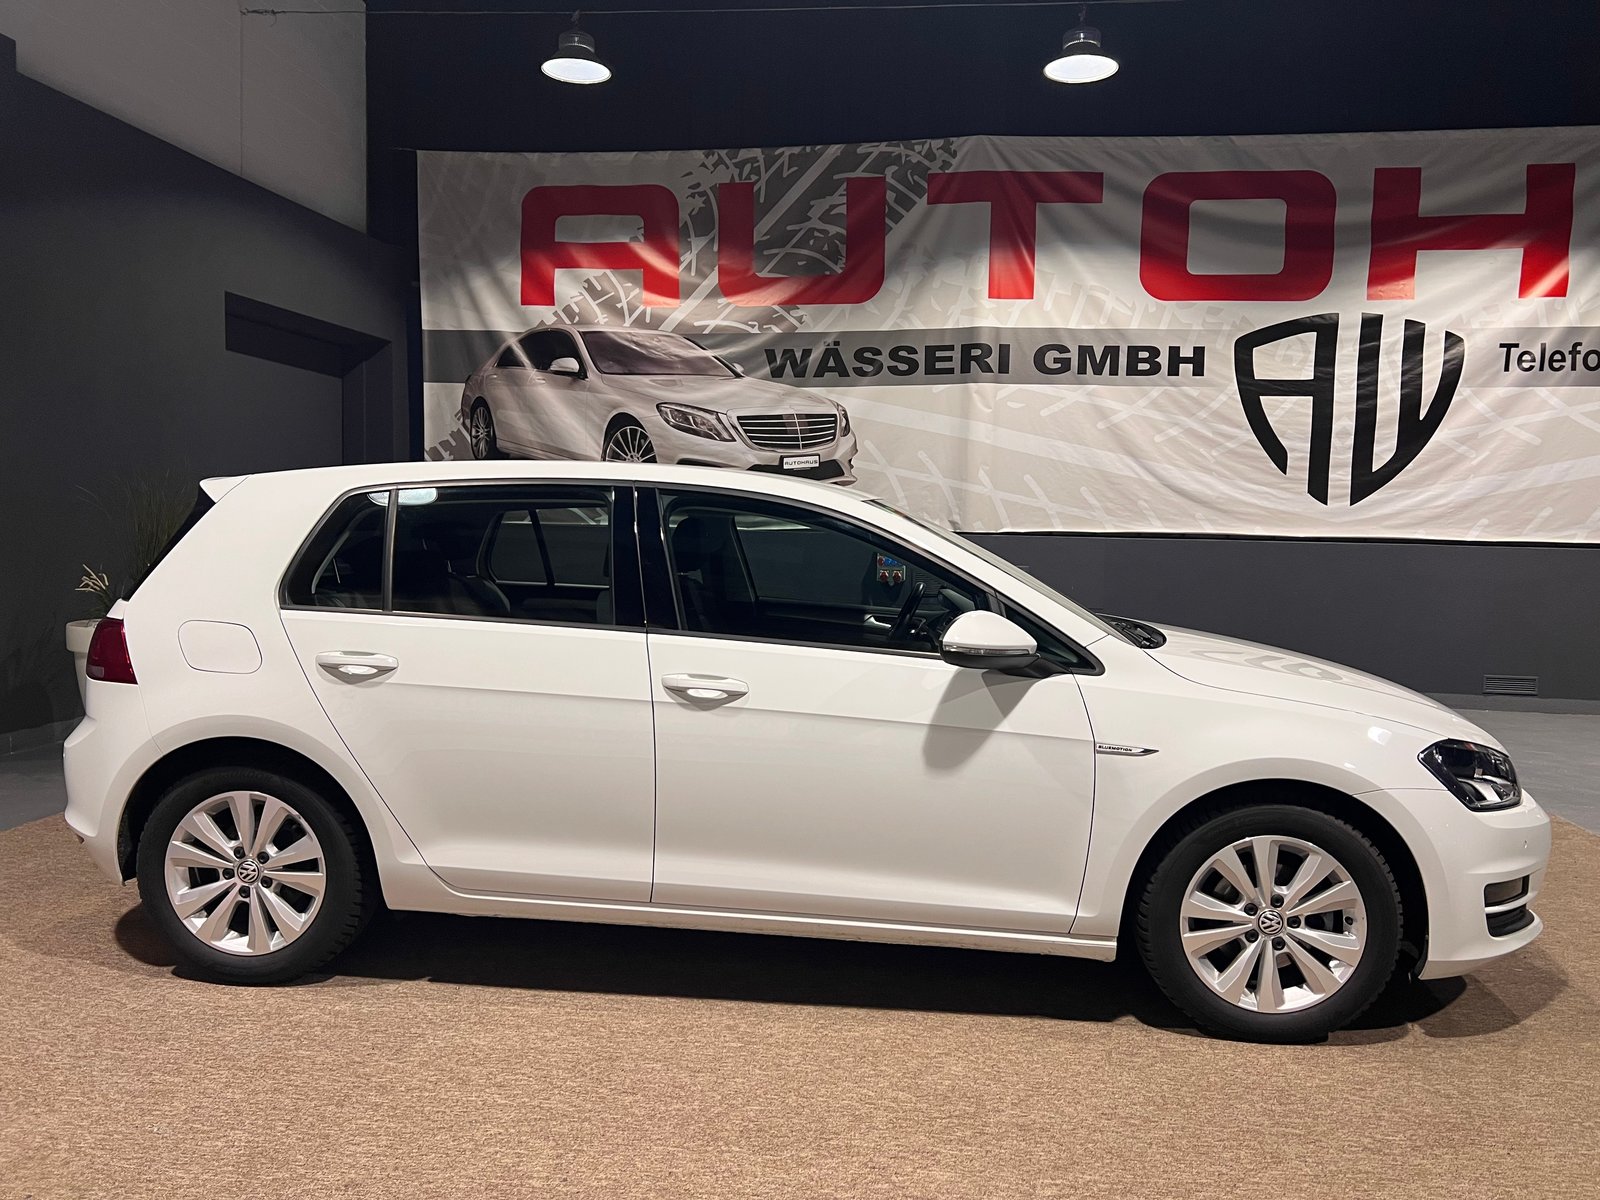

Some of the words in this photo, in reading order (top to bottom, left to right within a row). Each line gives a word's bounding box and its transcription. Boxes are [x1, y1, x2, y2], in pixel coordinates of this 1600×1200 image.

[520, 163, 1576, 306] AUTOH
[763, 340, 1011, 379] WÄSSERI
[1032, 343, 1206, 378] GMBH
[1498, 341, 1600, 373] Telefo
